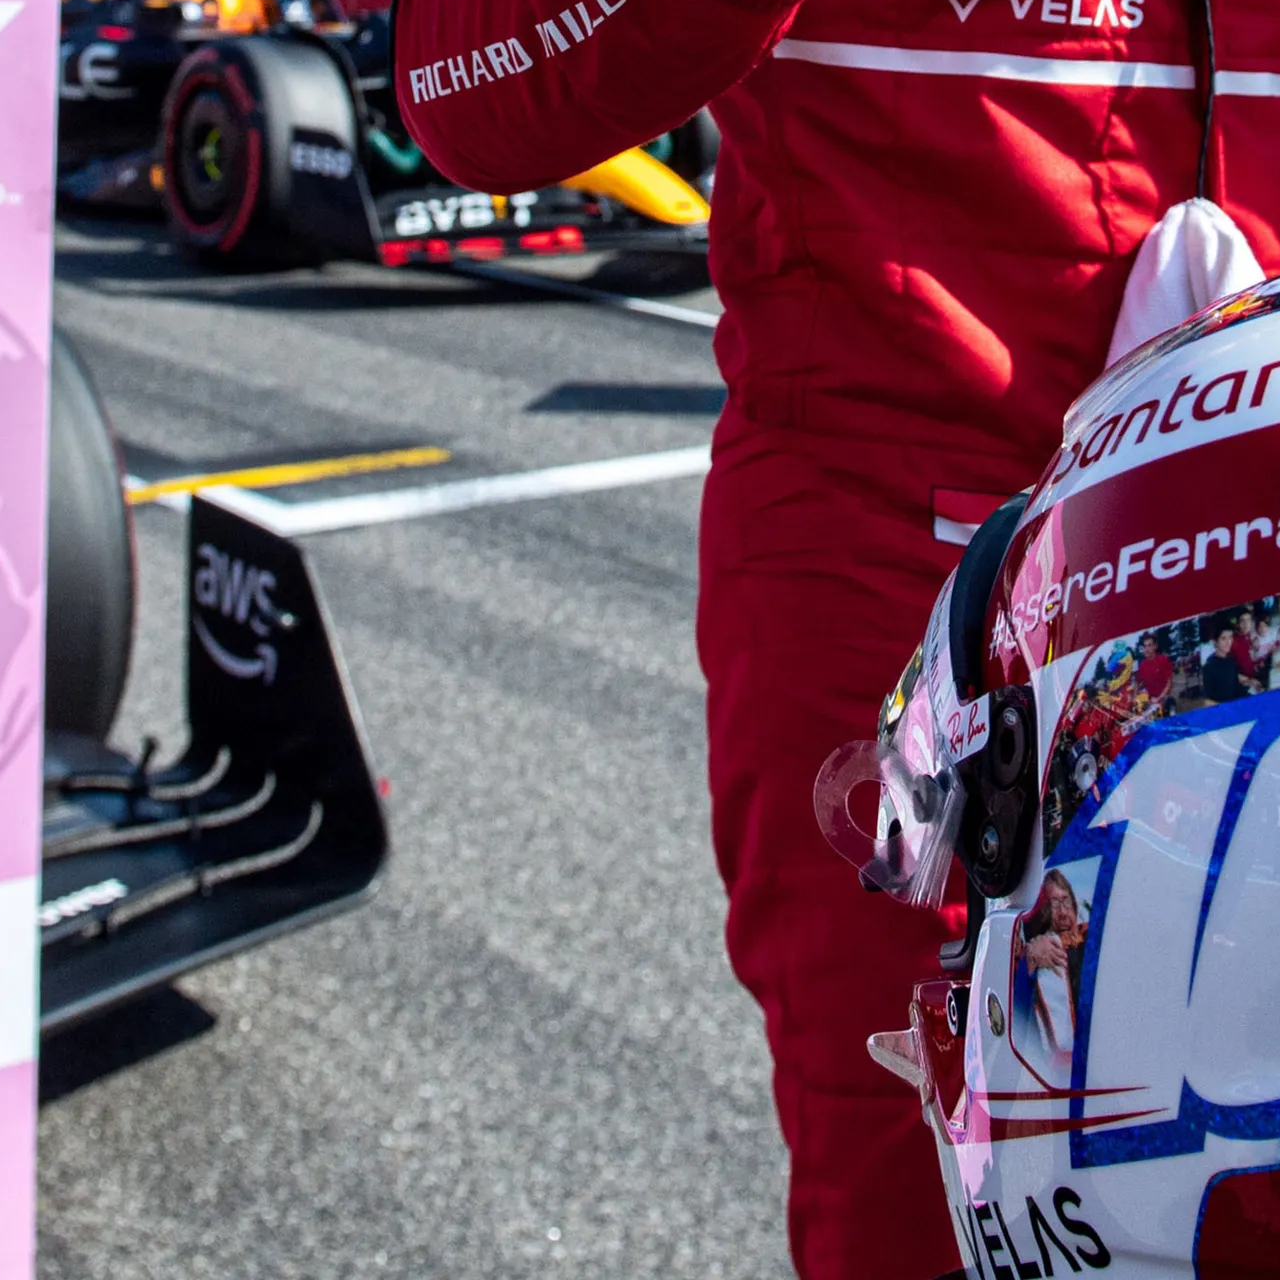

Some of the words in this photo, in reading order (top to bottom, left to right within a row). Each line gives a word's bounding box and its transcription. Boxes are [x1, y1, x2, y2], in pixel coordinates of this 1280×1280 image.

[408, 37, 535, 105] RICHARD
[195, 544, 277, 635] aws
[956, 1186, 1112, 1280] VELAS
